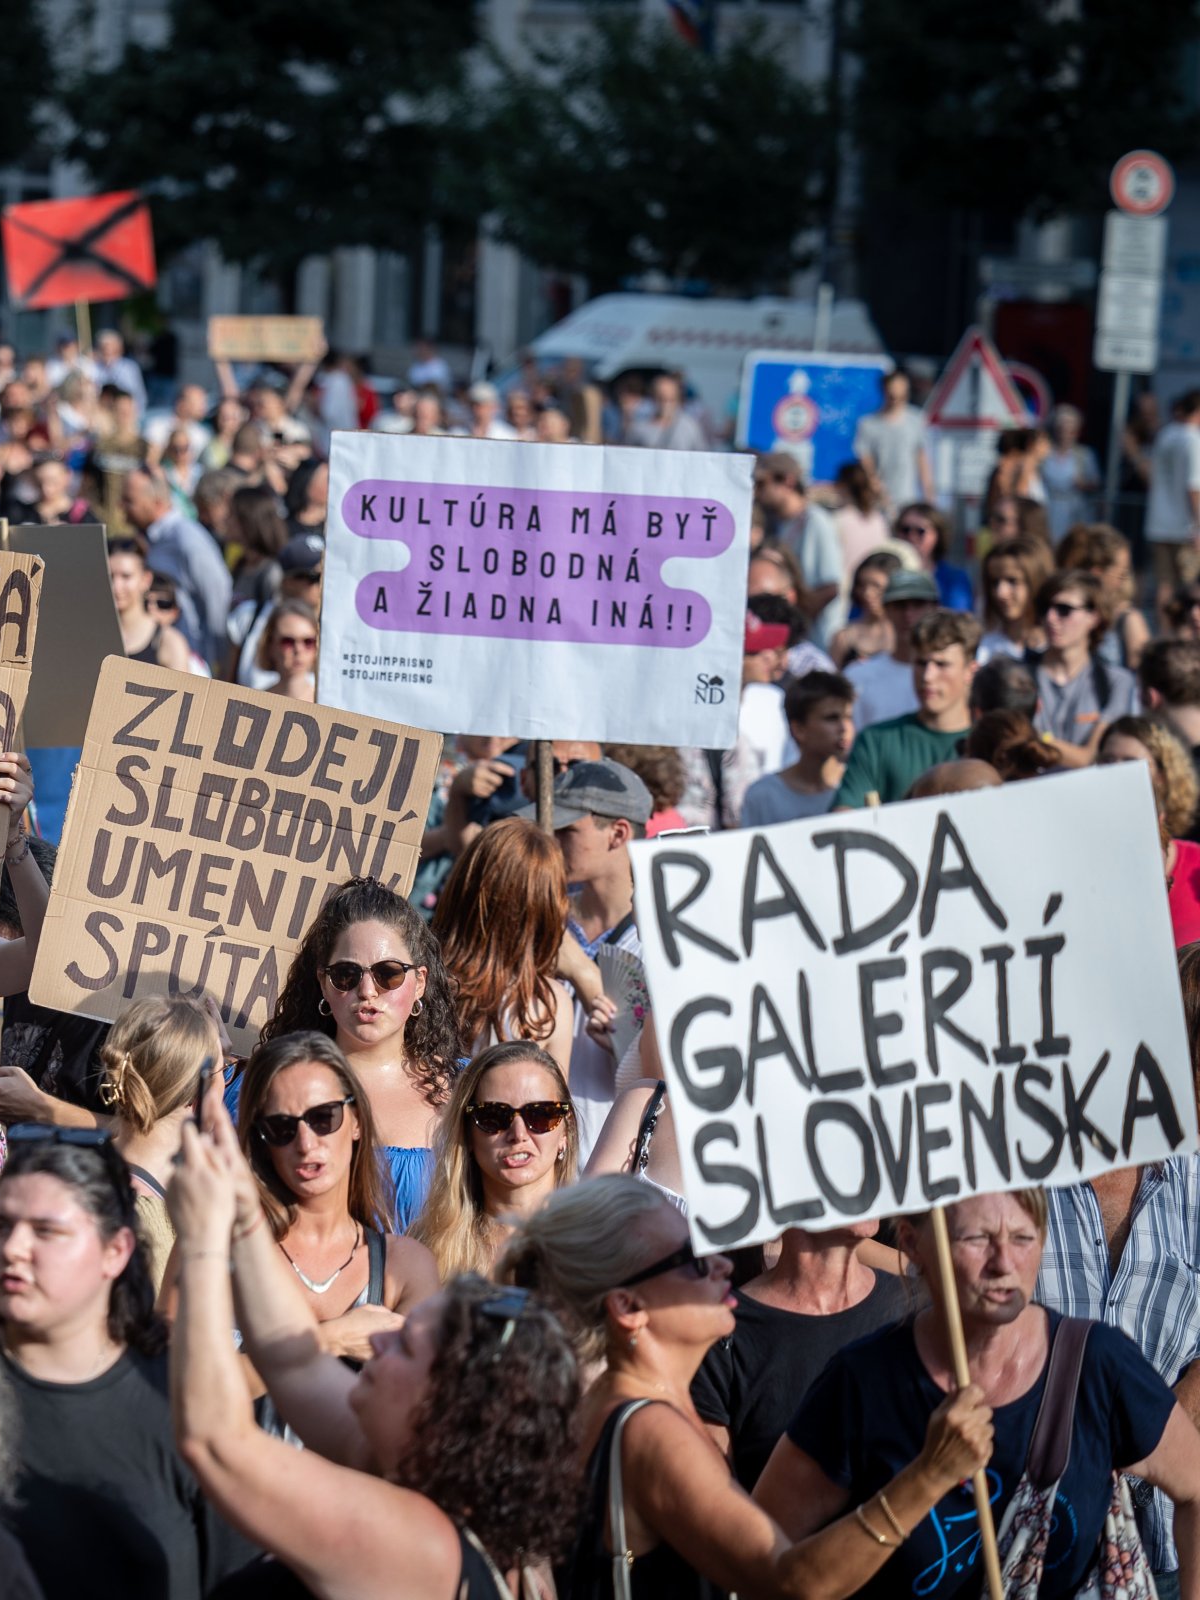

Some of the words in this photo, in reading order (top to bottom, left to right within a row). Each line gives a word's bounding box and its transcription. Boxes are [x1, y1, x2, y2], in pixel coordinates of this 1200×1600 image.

[360, 492, 541, 532] KULTÚRA
[571, 501, 618, 536] MÁ
[647, 506, 718, 542] BYŤ
[429, 544, 641, 583] SLOBODNÁ
[343, 653, 433, 670] #STOJIMPRISND
[373, 586, 389, 613] A
[416, 582, 562, 625] ŽIADNA
[591, 594, 693, 633] INÁ!!
[341, 669, 433, 685] #STOJIMEPRISNG
[112, 681, 420, 812] ZLODEJI
[105, 755, 419, 881] SLOBODNÍ
[86, 828, 340, 940] UMENI
[651, 810, 1008, 968] RADA
[64, 910, 280, 1030] SPÚTA
[669, 892, 1071, 1112] GALÉRIÍ
[693, 1041, 1185, 1246] SLOVENSKA
